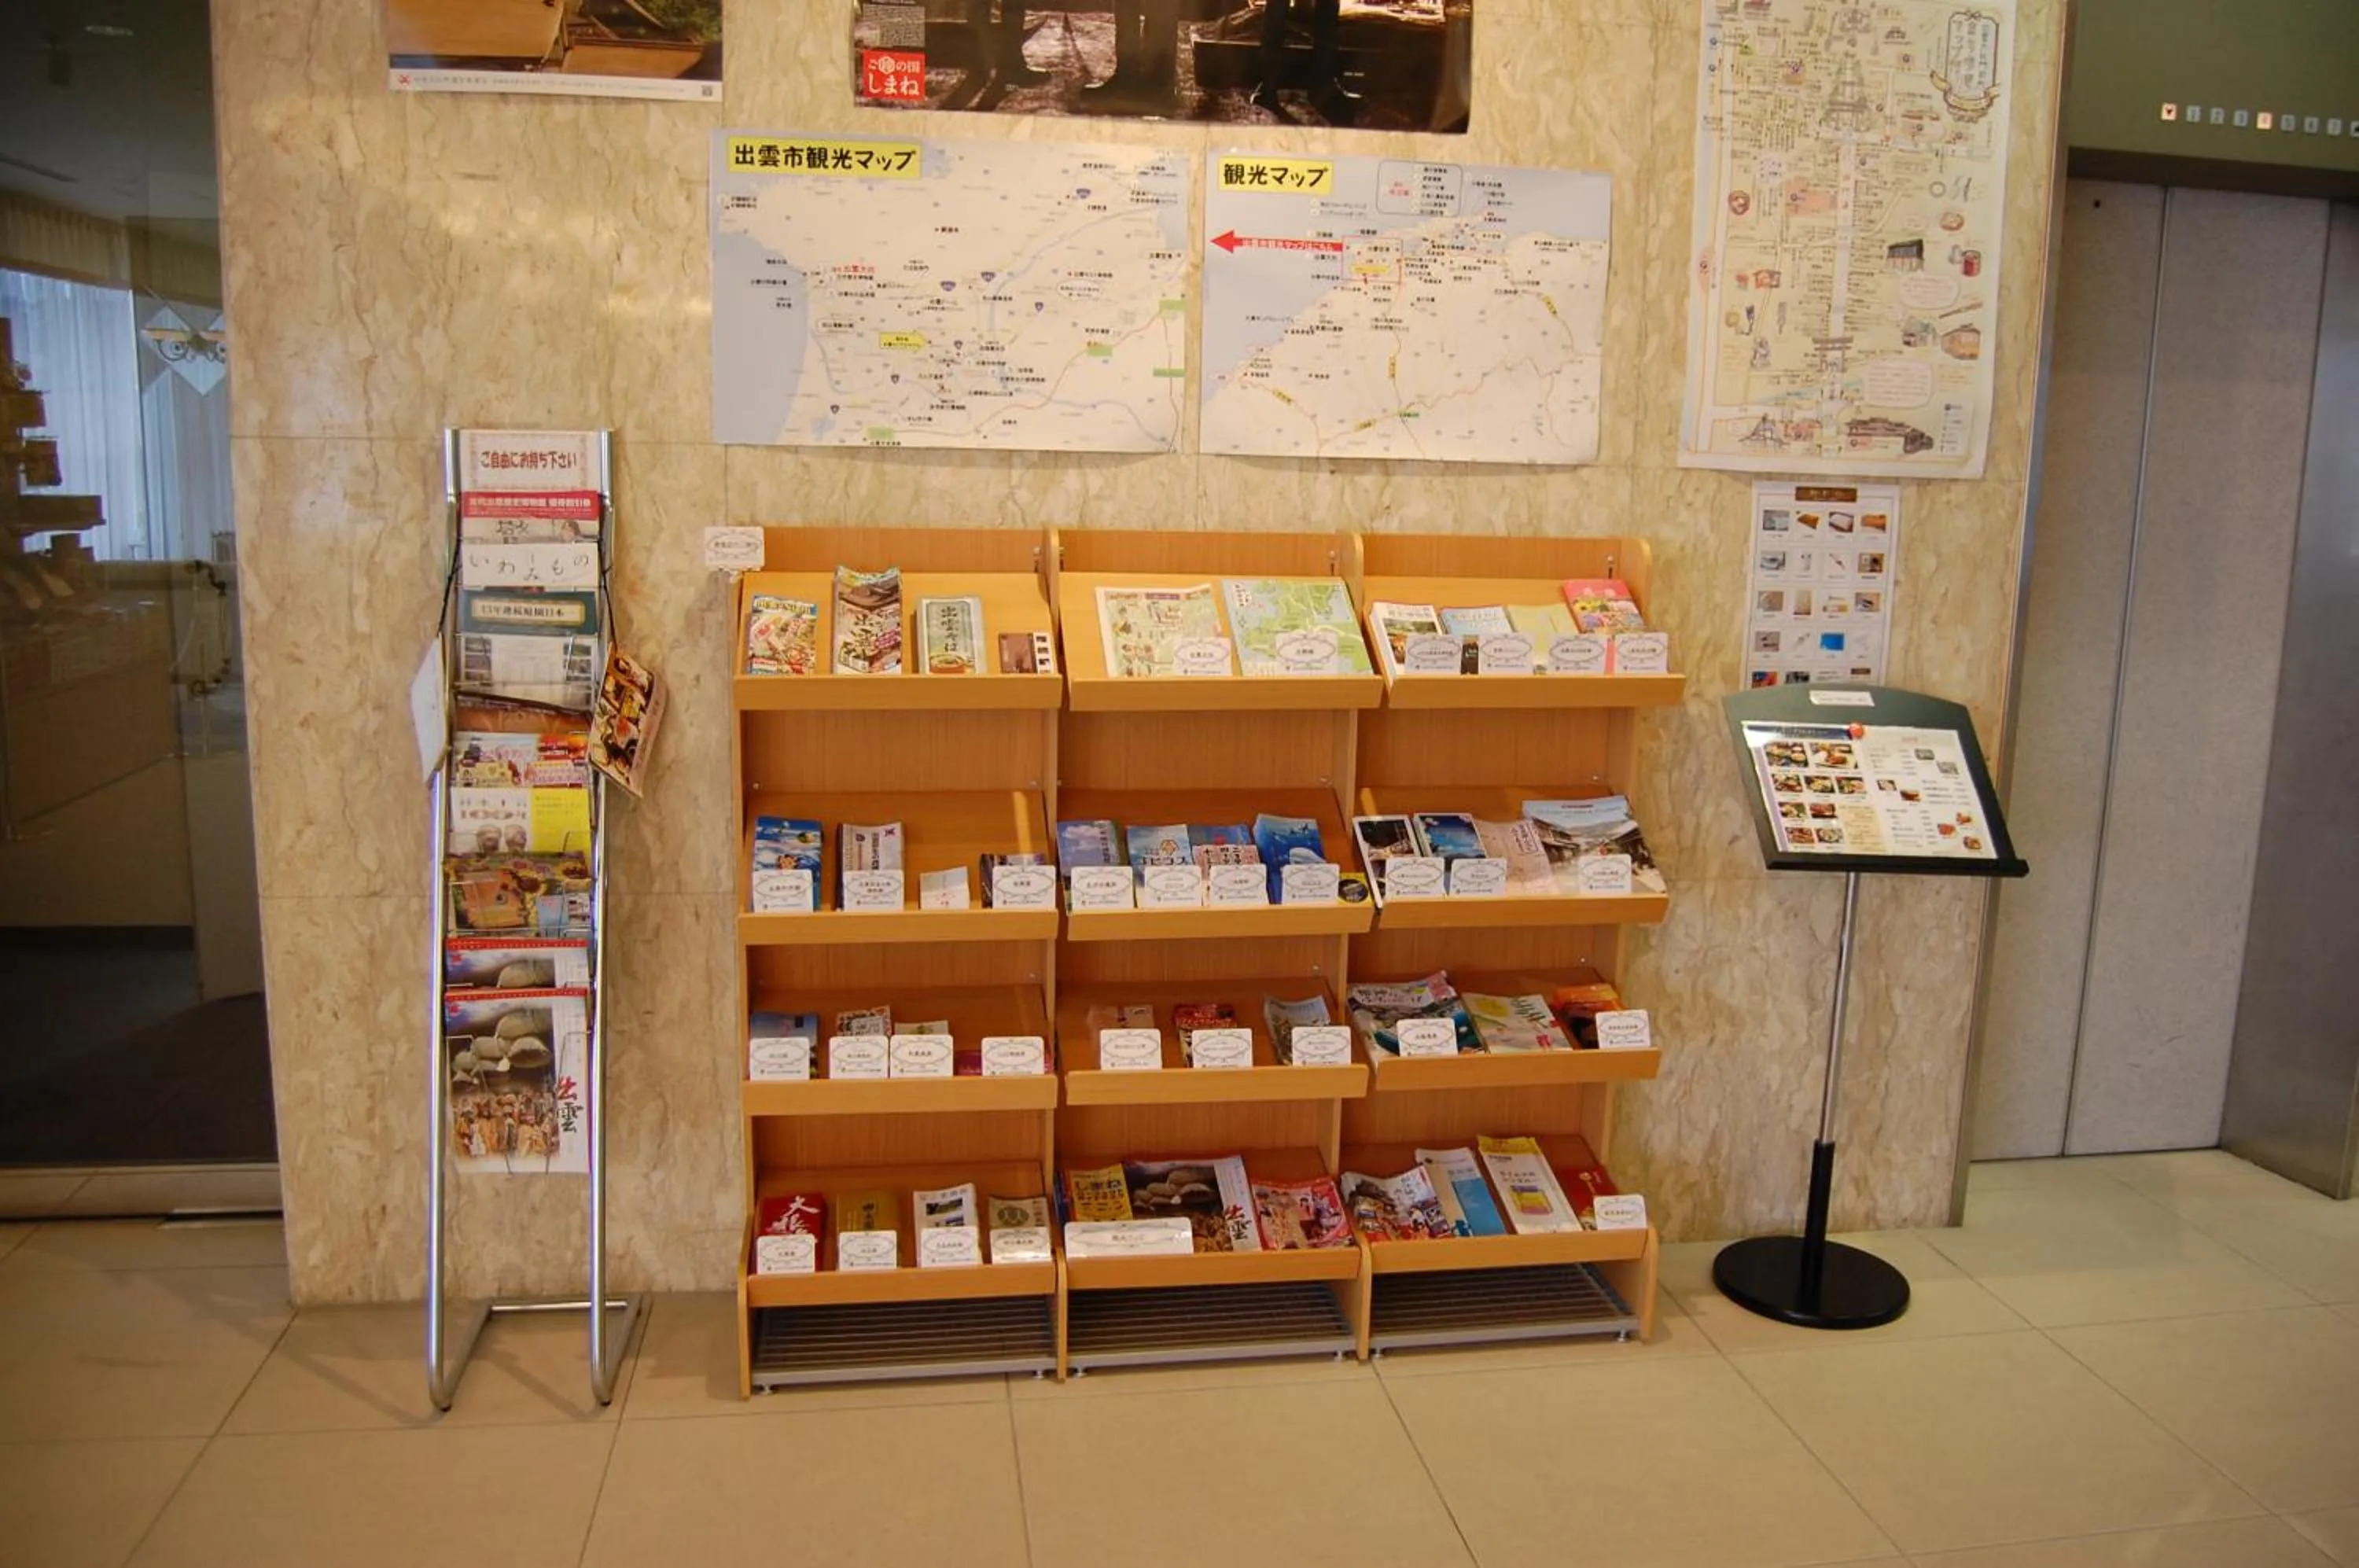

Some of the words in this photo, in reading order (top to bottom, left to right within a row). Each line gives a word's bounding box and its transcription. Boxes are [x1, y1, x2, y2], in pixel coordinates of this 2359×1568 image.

[868, 73, 920, 96] しまね
[734, 143, 917, 171] 出雲市観光マップ
[1224, 163, 1329, 188] 観光マップ
[480, 450, 578, 470] ご自由にお持ち下さい
